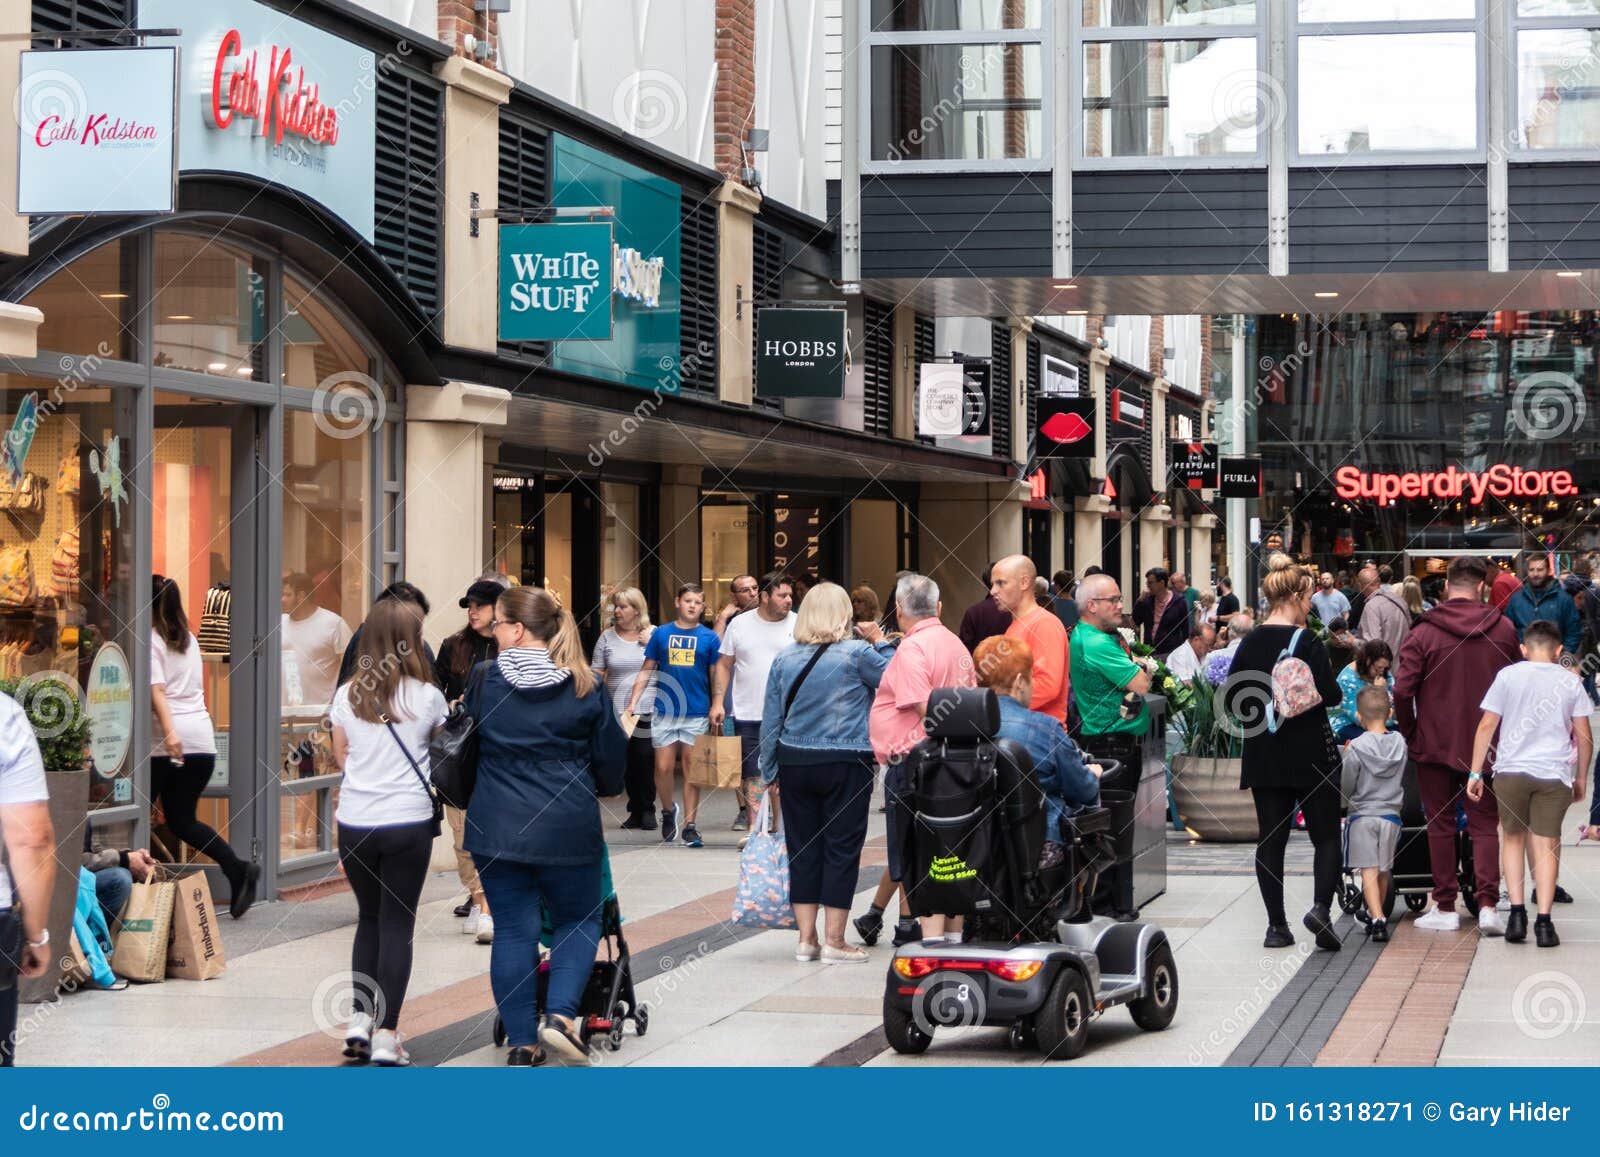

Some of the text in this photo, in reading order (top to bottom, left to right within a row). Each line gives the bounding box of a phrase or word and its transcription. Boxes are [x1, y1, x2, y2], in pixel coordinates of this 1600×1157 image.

[212, 29, 339, 145] Cath Kidston
[34, 113, 158, 148] Cath Kidston
[764, 340, 837, 357] HOBBS
[1224, 473, 1257, 483] FURLA
[195, 903, 216, 962] Timberland
[957, 984, 969, 1001] 3
